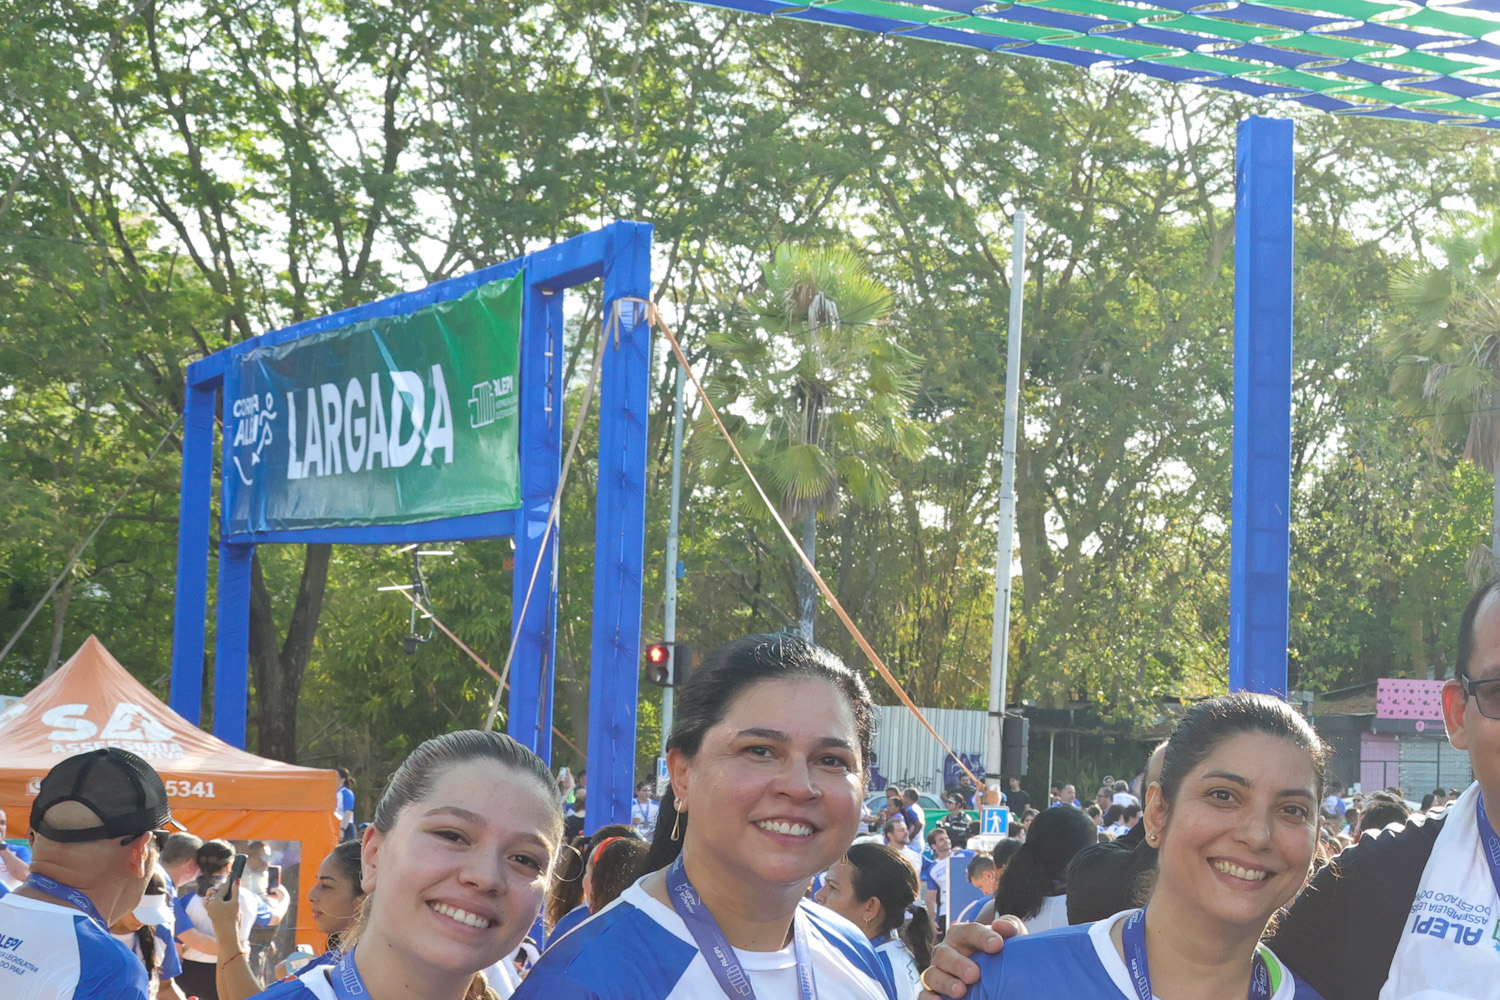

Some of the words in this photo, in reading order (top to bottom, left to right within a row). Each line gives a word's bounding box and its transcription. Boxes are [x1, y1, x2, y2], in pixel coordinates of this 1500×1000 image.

[287, 363, 454, 480] LARGADA
[1428, 902, 1489, 925] ASSEMBLEIA
[1434, 892, 1474, 913] ESTADO
[1474, 904, 1492, 916] DO
[1411, 914, 1484, 946] ALEPI
[712, 945, 729, 968] ALEPI
